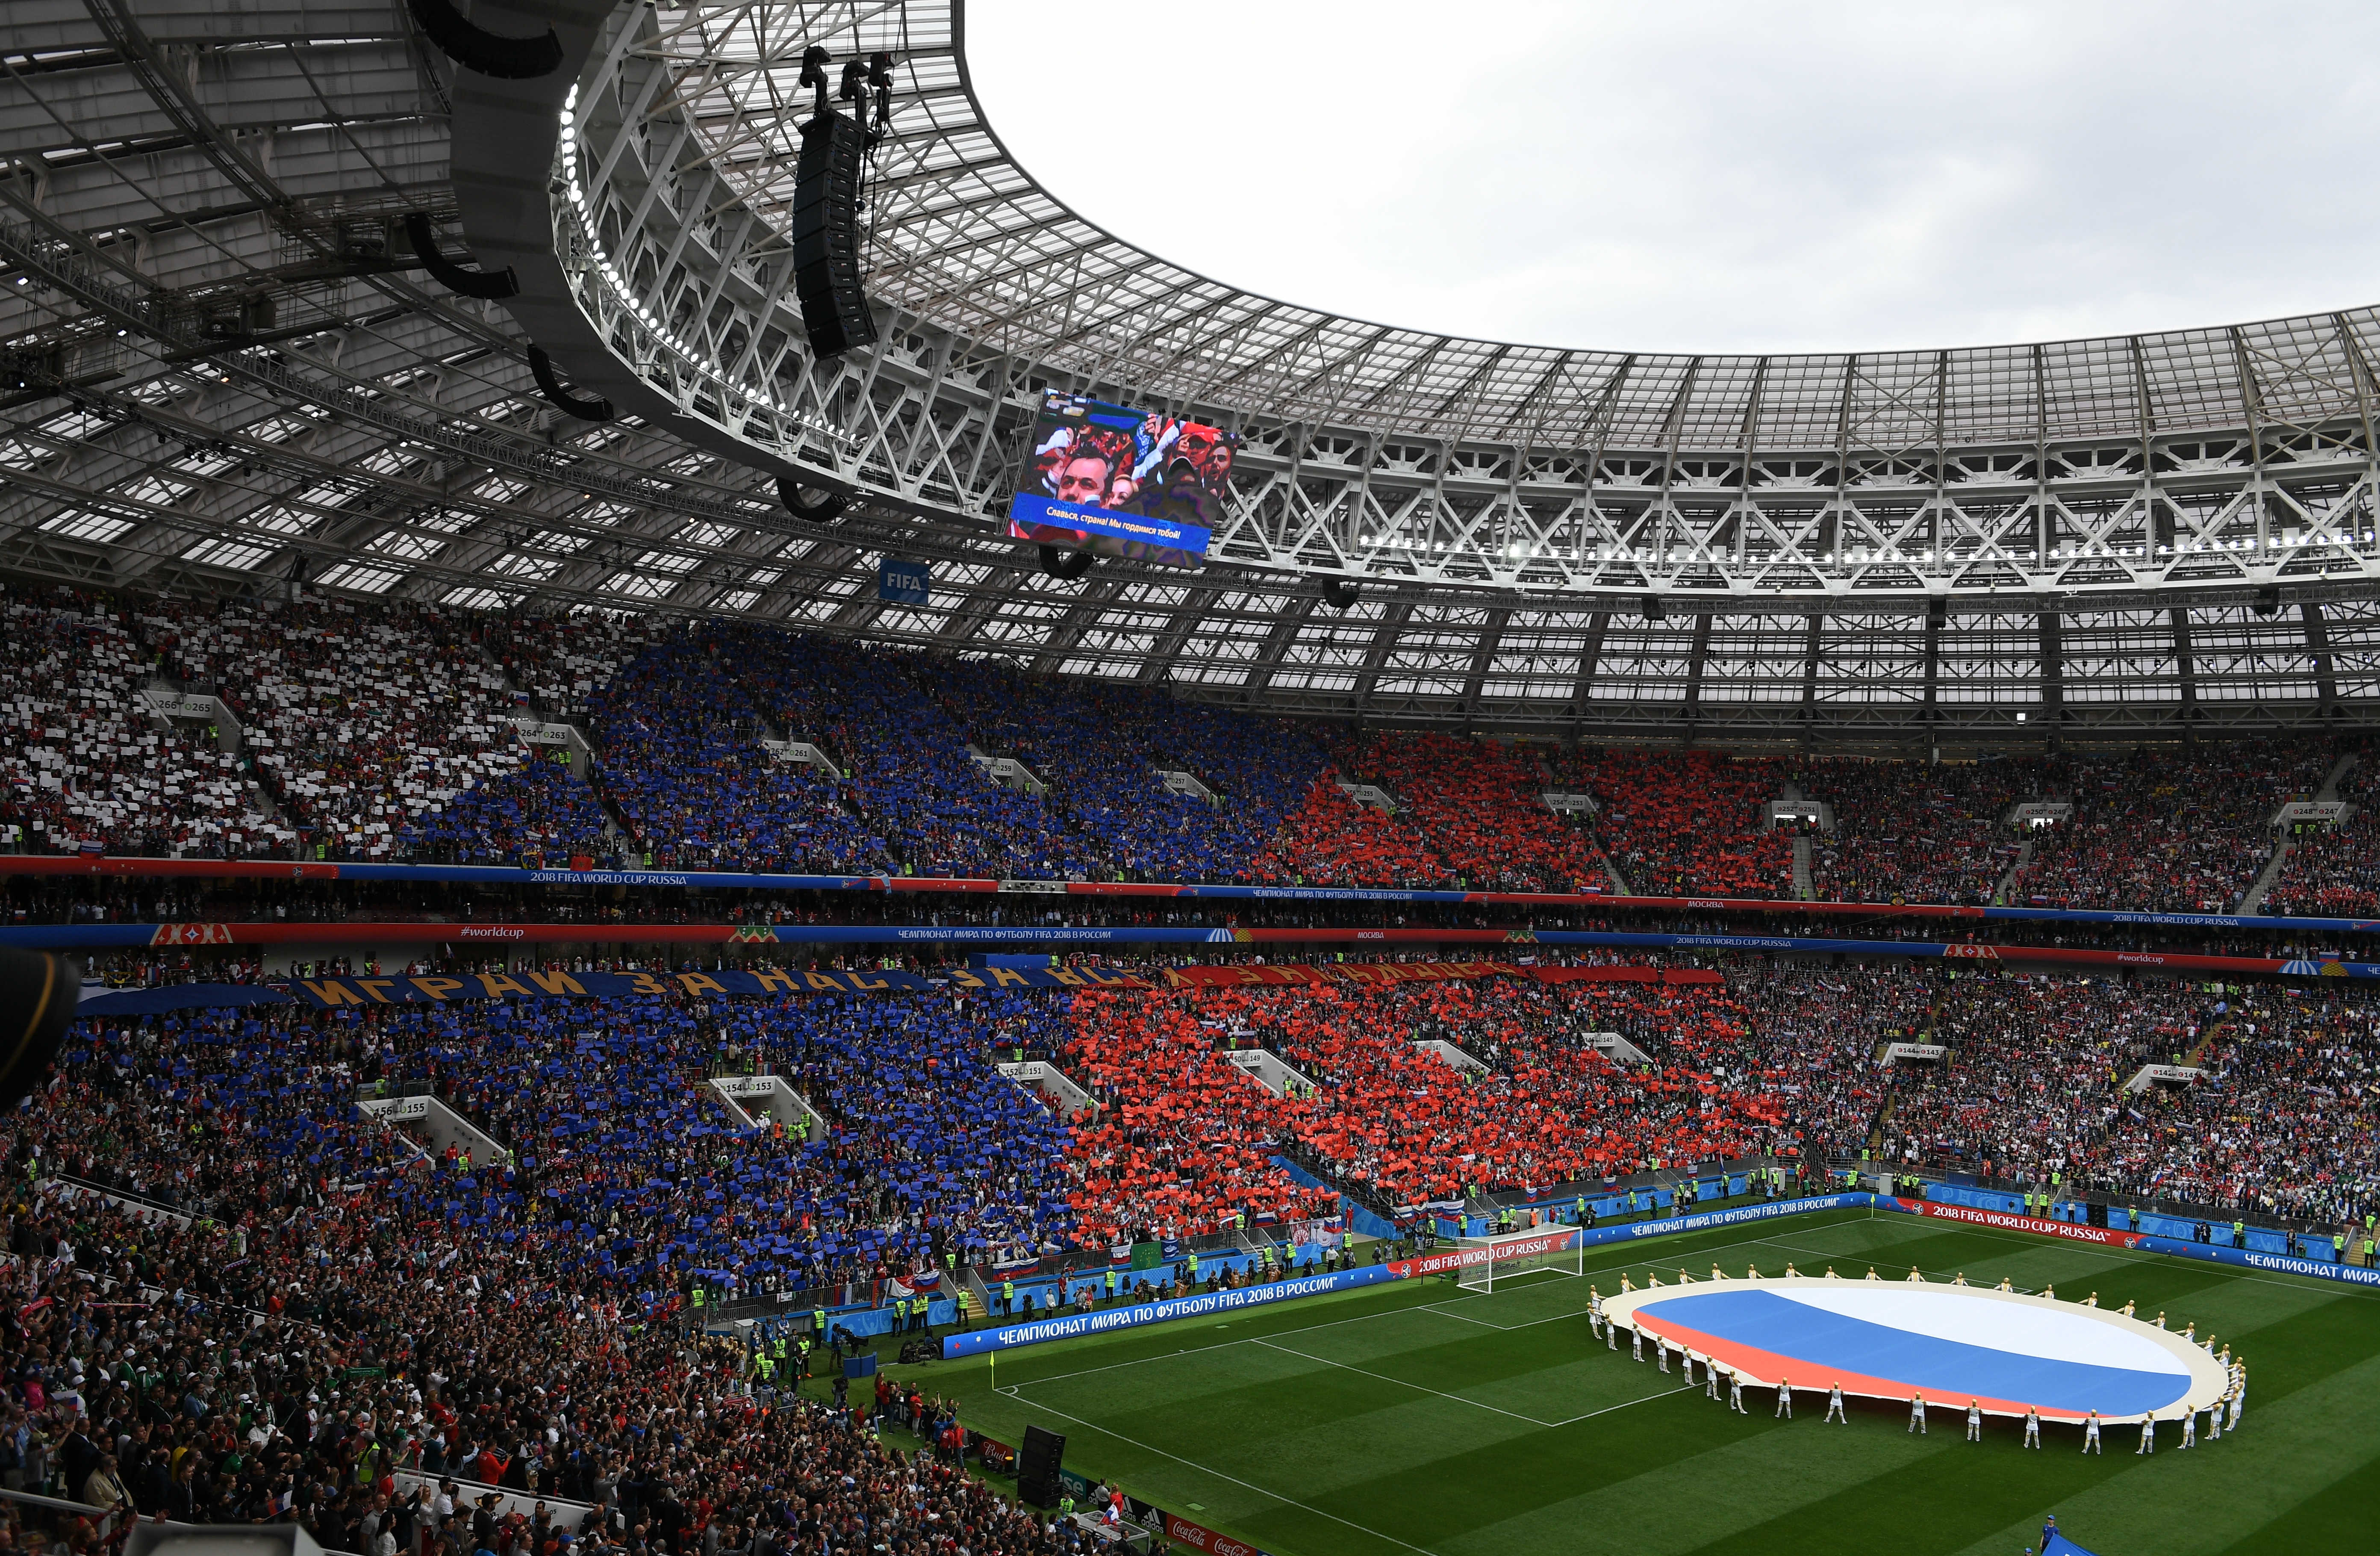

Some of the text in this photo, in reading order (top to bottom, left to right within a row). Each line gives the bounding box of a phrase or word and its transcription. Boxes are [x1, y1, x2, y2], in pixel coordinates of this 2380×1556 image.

[1046, 507, 1181, 540] Славься, страна! Мы гордимся тобой!
[887, 572, 921, 591] FIFA
[159, 700, 177, 709] 266
[192, 703, 210, 712] 265
[530, 872, 556, 882] 2018
[558, 873, 582, 883] FIFA
[583, 874, 623, 884] WORLD
[624, 875, 647, 884] CUP
[1253, 890, 1294, 898] ЧЕМПИОНАТ
[2153, 916, 2183, 924] WORLD
[460, 926, 524, 939] #worldcup
[898, 930, 953, 938] ЧЕМПИОНАТ
[954, 930, 979, 938] МИРА
[981, 930, 993, 938] ПО
[995, 930, 1034, 939] ФУТБОЛУ
[1035, 930, 1052, 939] FIFA
[1053, 930, 1071, 939] 2018
[1072, 931, 1078, 939] В
[2117, 953, 2164, 964] #worldcup
[613, 971, 728, 996] ЗА
[726, 1082, 772, 1092] 154 153
[375, 1103, 425, 1116] 156 155
[1632, 1220, 1683, 1236] ЧЕМПИОНАТ
[1686, 1216, 1710, 1229] МИРА
[1712, 1213, 1723, 1224] ПО
[1725, 1208, 1761, 1222] ФУТБОЛУ
[1762, 1205, 1778, 1217] FIFA
[1779, 1202, 1797, 1214] 2018
[1798, 1201, 1803, 1211] В
[1933, 1206, 1959, 1218] 2018
[1961, 1210, 1985, 1223] FIFA
[1987, 1214, 2029, 1229] WORLD
[2031, 1221, 2057, 1233] CUP
[1419, 1258, 1440, 1273] 2018
[1442, 1255, 1461, 1268] FIFA
[1462, 1250, 1495, 1266] WORLD
[1496, 1246, 1515, 1258] CUP
[2245, 1253, 2339, 1278] ЧЕМПИОНАТ
[999, 1318, 1088, 1344] ЧЕМПИОНАТ
[1091, 1311, 1131, 1330] МИРА
[1134, 1307, 1153, 1322] ПО
[1157, 1296, 1216, 1318] ФУТБОЛУ
[1219, 1292, 1244, 1308] FIFA
[1247, 1287, 1274, 1303] 2018
[1277, 1285, 1284, 1298] В
[983, 1441, 1007, 1462] Bud
[1088, 1496, 1098, 1506] adi
[1121, 1509, 1136, 1522] idas
[1141, 1519, 1164, 1534] adidas
[1173, 1521, 1207, 1547] Coca-Cola
